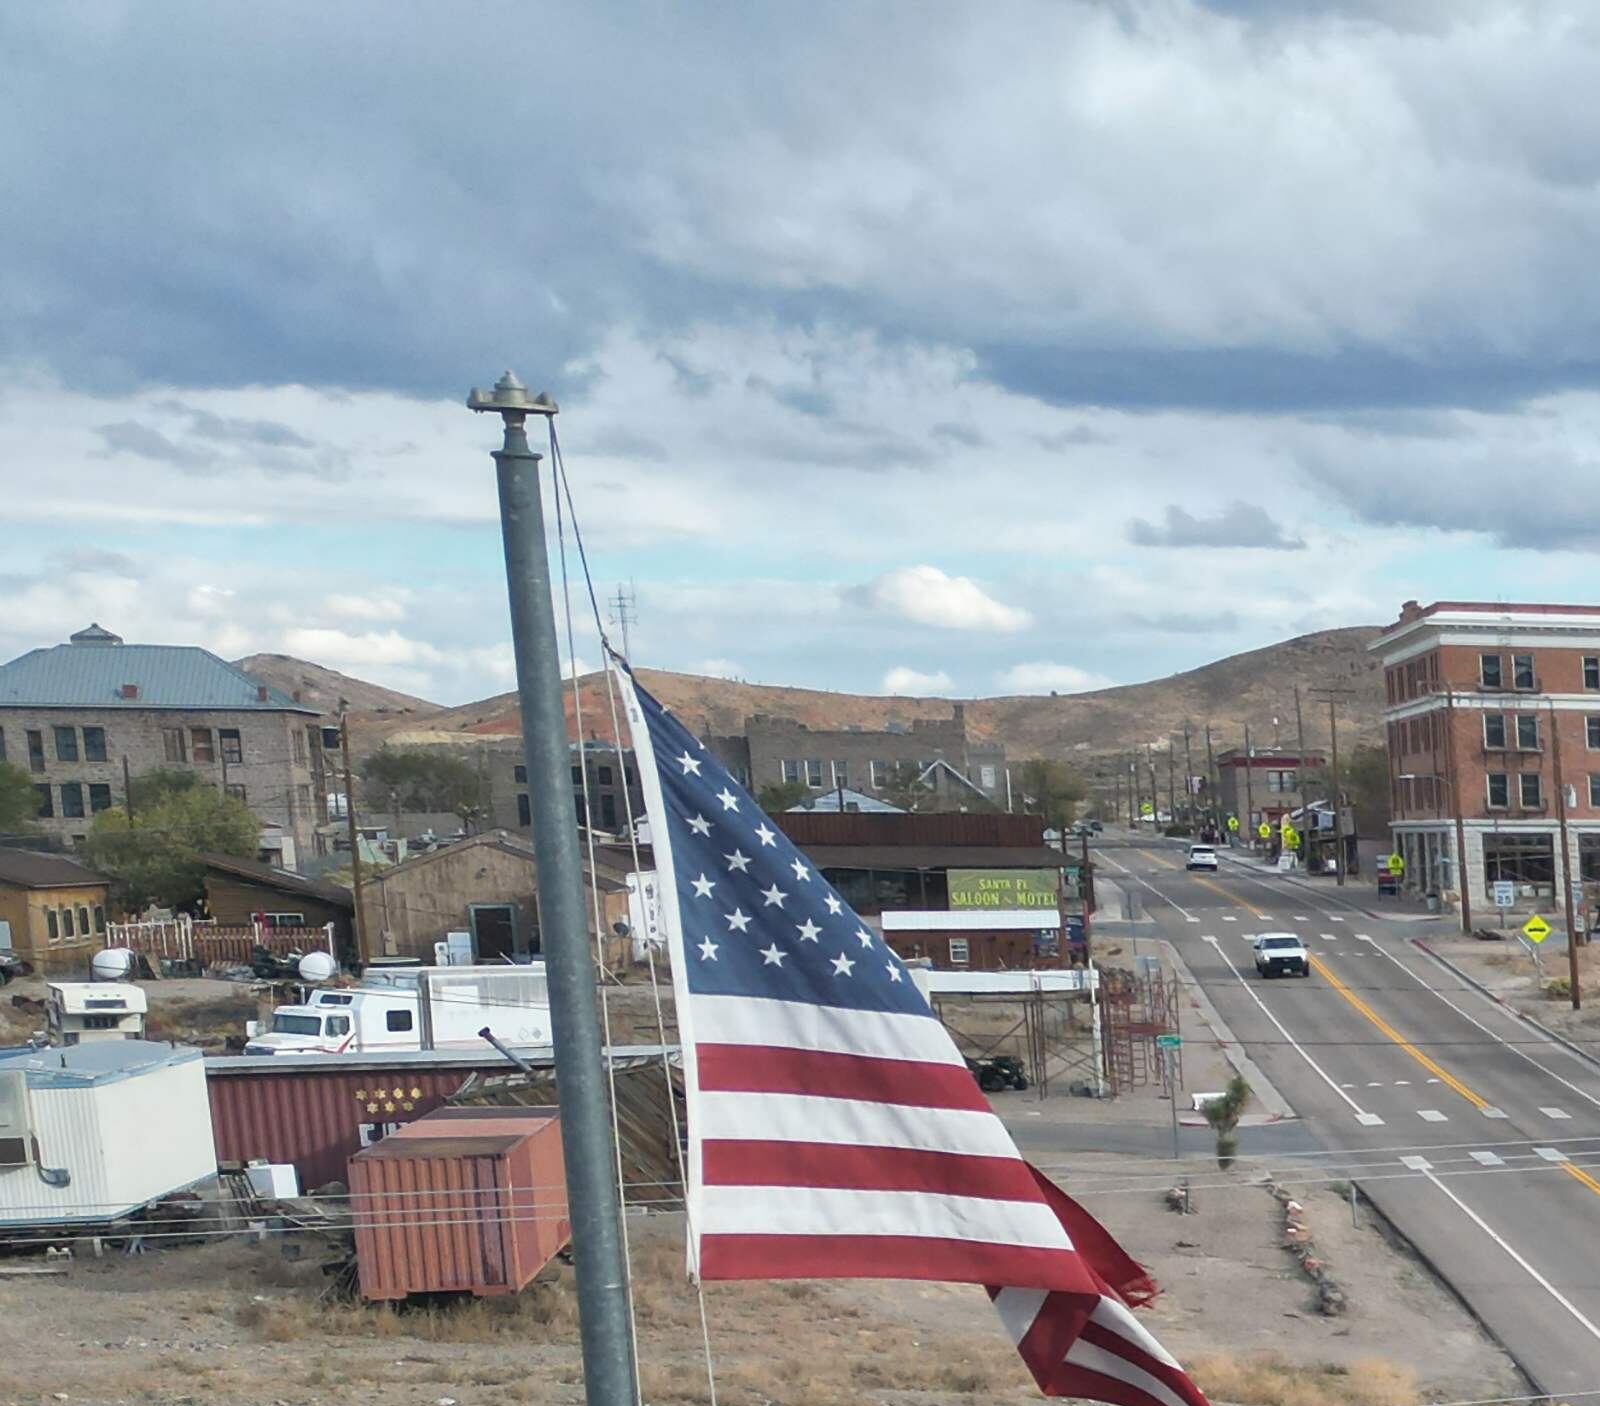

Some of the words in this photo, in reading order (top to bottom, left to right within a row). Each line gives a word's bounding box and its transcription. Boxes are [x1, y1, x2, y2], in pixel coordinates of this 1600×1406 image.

[978, 878, 1011, 890] SANTA
[952, 891, 1000, 906] SALOON
[1016, 891, 1057, 906] MOTEL
